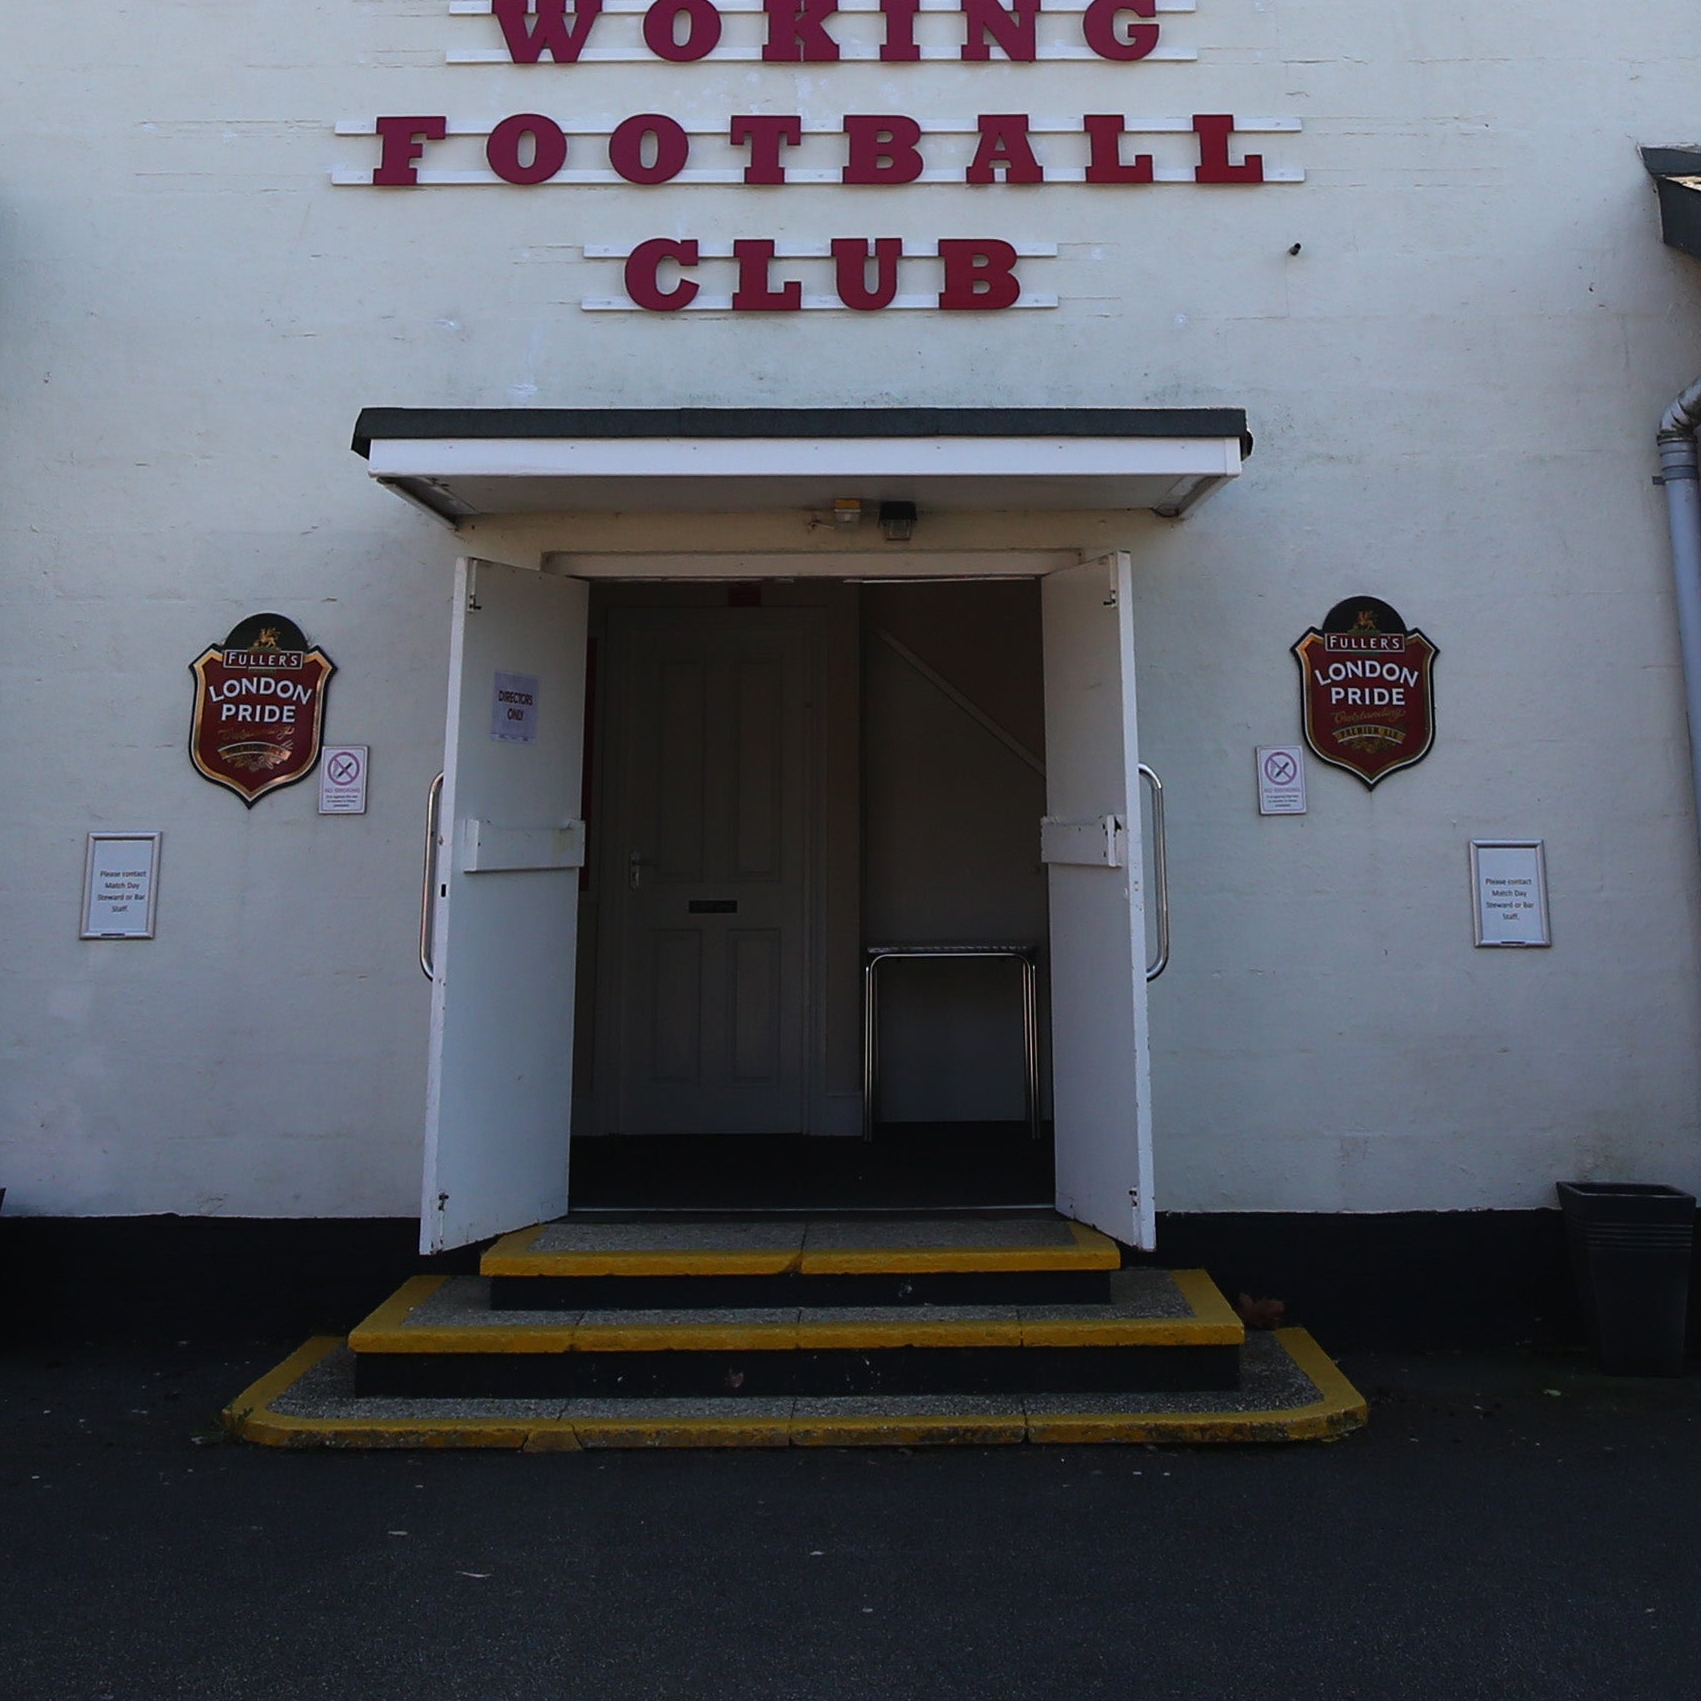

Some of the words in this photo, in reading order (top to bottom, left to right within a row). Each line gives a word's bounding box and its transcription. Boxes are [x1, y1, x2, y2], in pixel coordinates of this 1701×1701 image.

[372, 112, 1265, 187] FOOTBALL
[623, 236, 1022, 312] CLUB
[1330, 636, 1400, 649] FULLER'S
[228, 652, 298, 667] FULLER'S
[1315, 660, 1419, 688] LONDON
[209, 677, 312, 705] LONDON
[499, 690, 533, 706] DIRECTORS
[1331, 688, 1406, 706] PRIDE
[221, 704, 296, 723] PRIDE
[1514, 890, 1527, 898] Day
